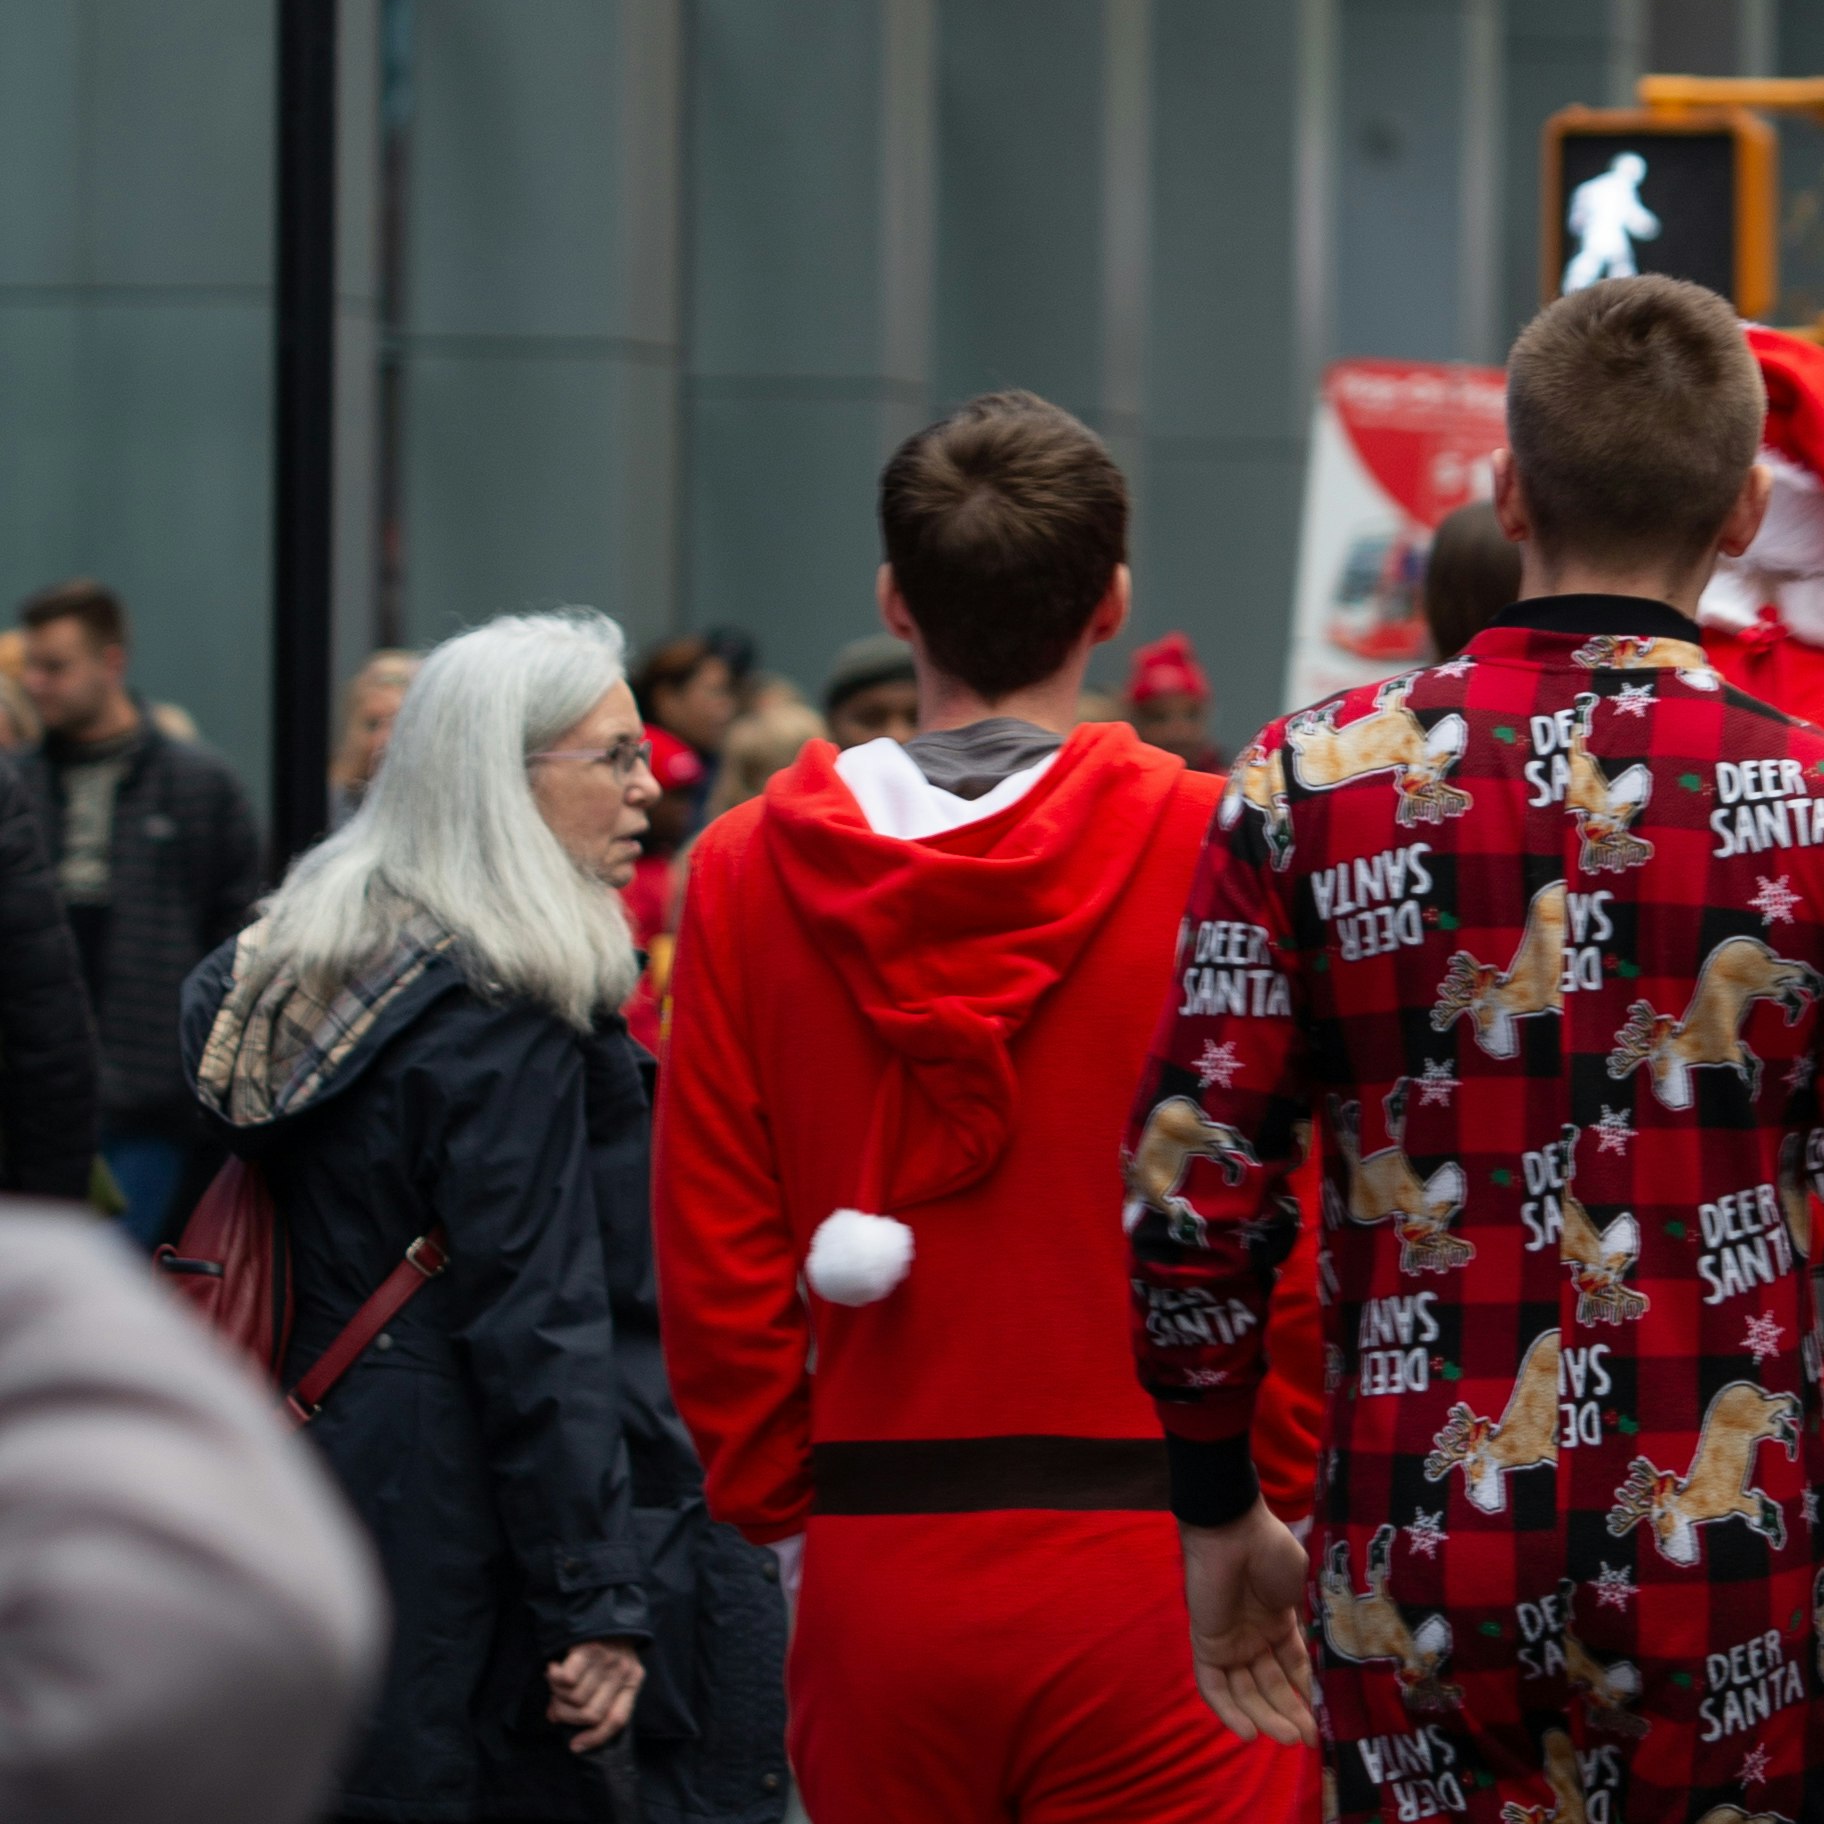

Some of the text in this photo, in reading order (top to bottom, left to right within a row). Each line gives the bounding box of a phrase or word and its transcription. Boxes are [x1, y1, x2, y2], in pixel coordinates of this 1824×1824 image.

[1715, 759, 1807, 803] DEER
[1311, 842, 1434, 921] SANTA
[1195, 920, 1270, 965] DEER
[1337, 900, 1425, 961] DEER
[1178, 967, 1293, 1017] SANTA
[1699, 1183, 1781, 1249] DEER
[1145, 1297, 1257, 1347] SANTA
[1706, 1628, 1786, 1687] DEER
[1699, 1659, 1804, 1743] SANTA
[1357, 1724, 1456, 1785] SANTA
